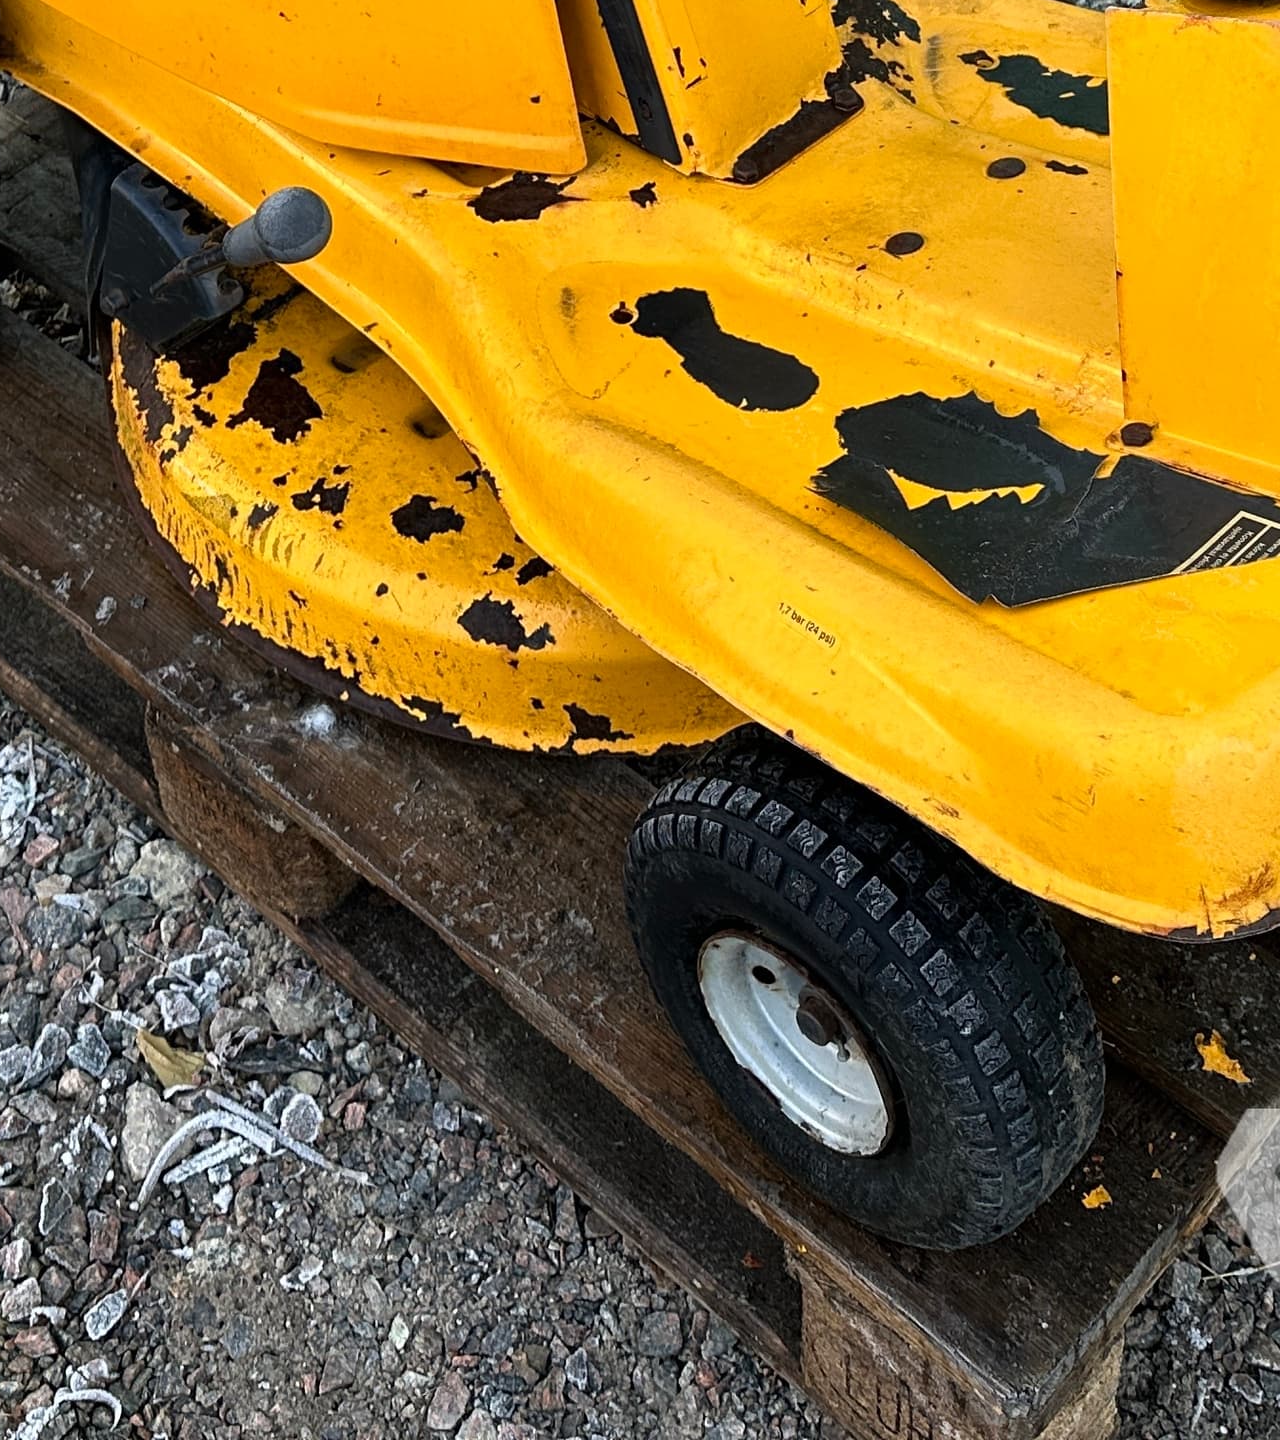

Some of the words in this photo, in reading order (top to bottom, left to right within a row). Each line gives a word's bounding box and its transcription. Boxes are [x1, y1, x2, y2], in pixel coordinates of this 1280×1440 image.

[779, 602, 791, 615] 1,7
[791, 610, 806, 625] bar
[805, 620, 819, 635] (24
[818, 630, 836, 648] psi)
